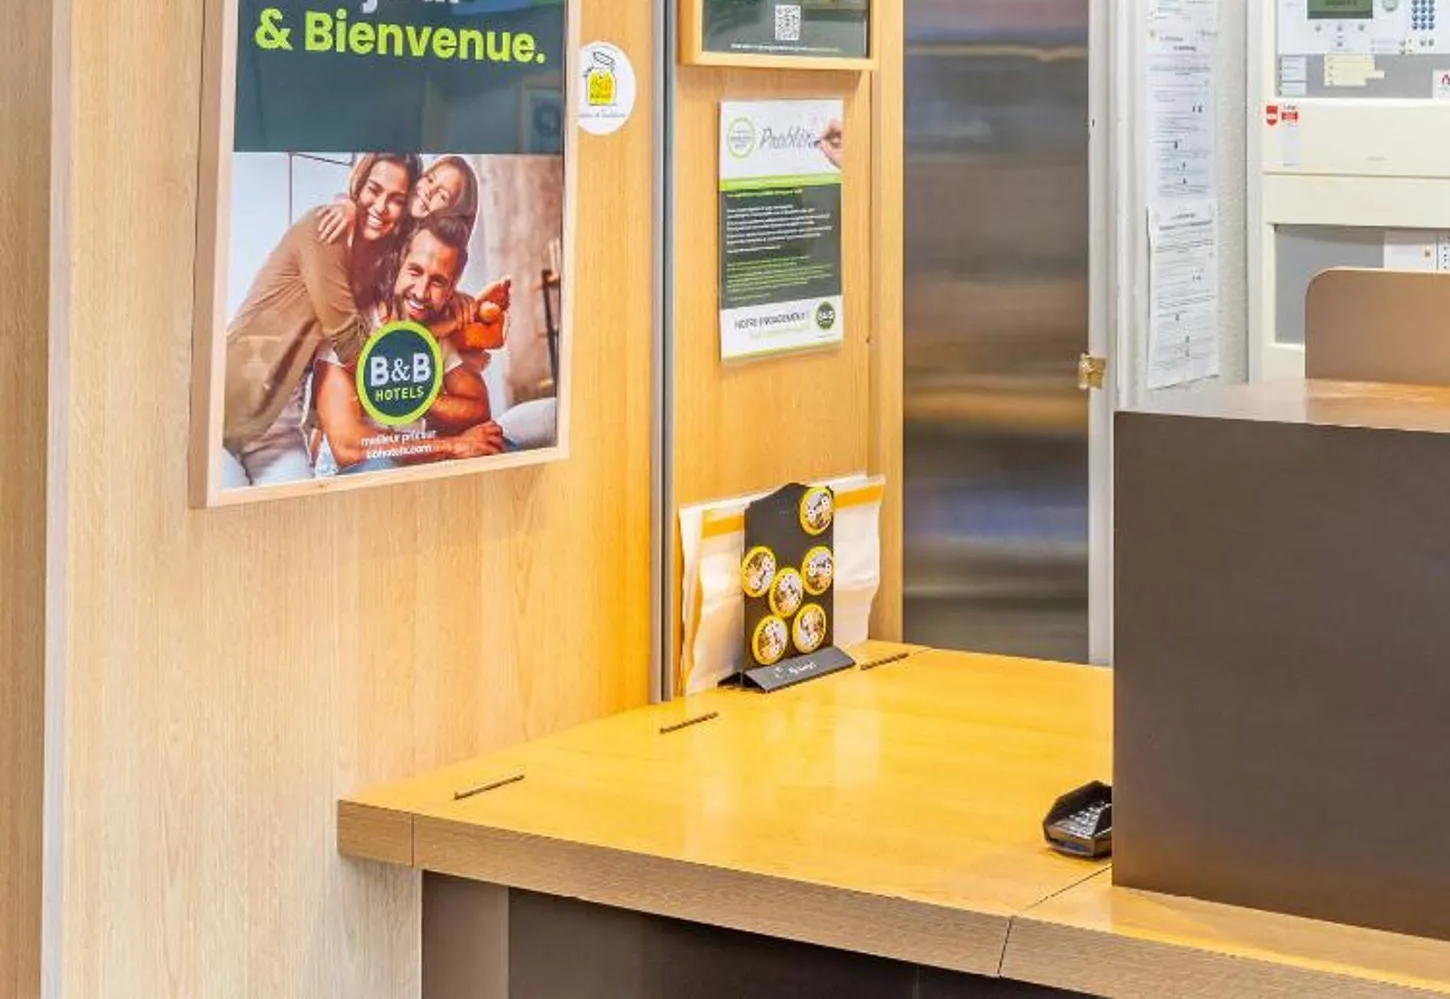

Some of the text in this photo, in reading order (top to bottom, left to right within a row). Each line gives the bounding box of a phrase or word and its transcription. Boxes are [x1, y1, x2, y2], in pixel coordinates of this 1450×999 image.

[254, 8, 547, 65] & Bienvenue.
[370, 352, 431, 387] B&B
[375, 385, 425, 402] HOTELS
